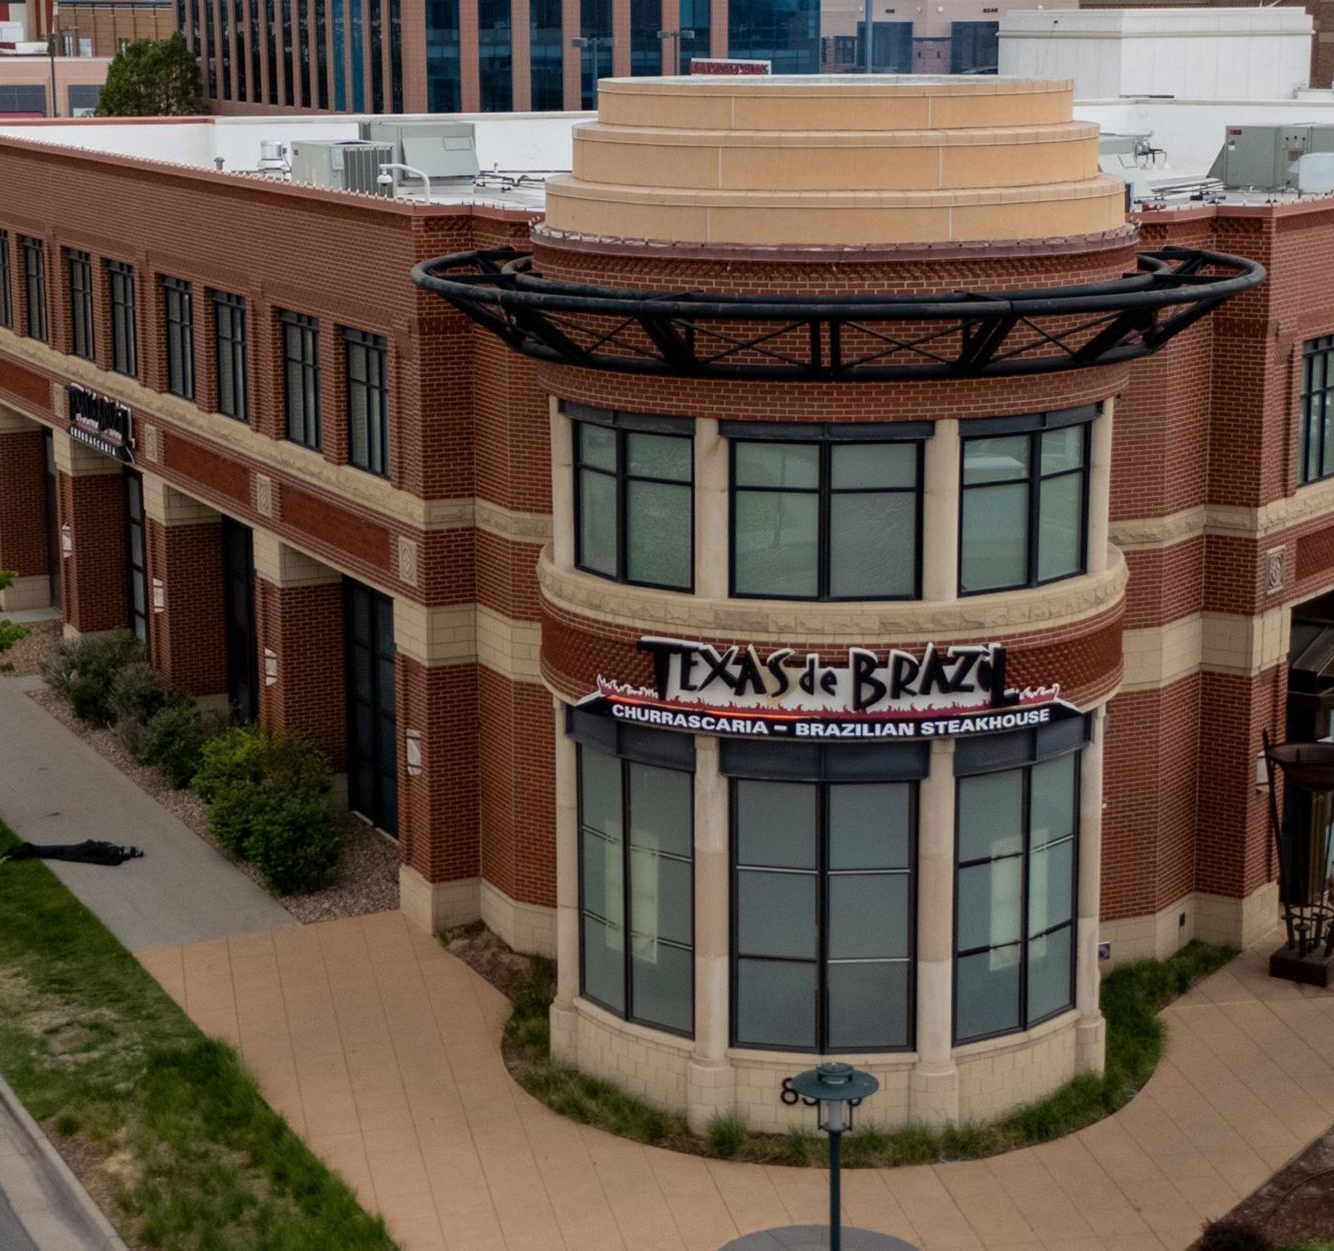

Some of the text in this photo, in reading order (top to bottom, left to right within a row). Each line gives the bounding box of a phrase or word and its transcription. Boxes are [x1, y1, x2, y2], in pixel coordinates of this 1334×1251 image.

[637, 636, 795, 701] TEXAS
[799, 654, 838, 697] de
[612, 704, 769, 735] CHURRASCARIA
[795, 722, 915, 737] BRAZILIAN
[920, 708, 1050, 736] STEAKHOUSE
